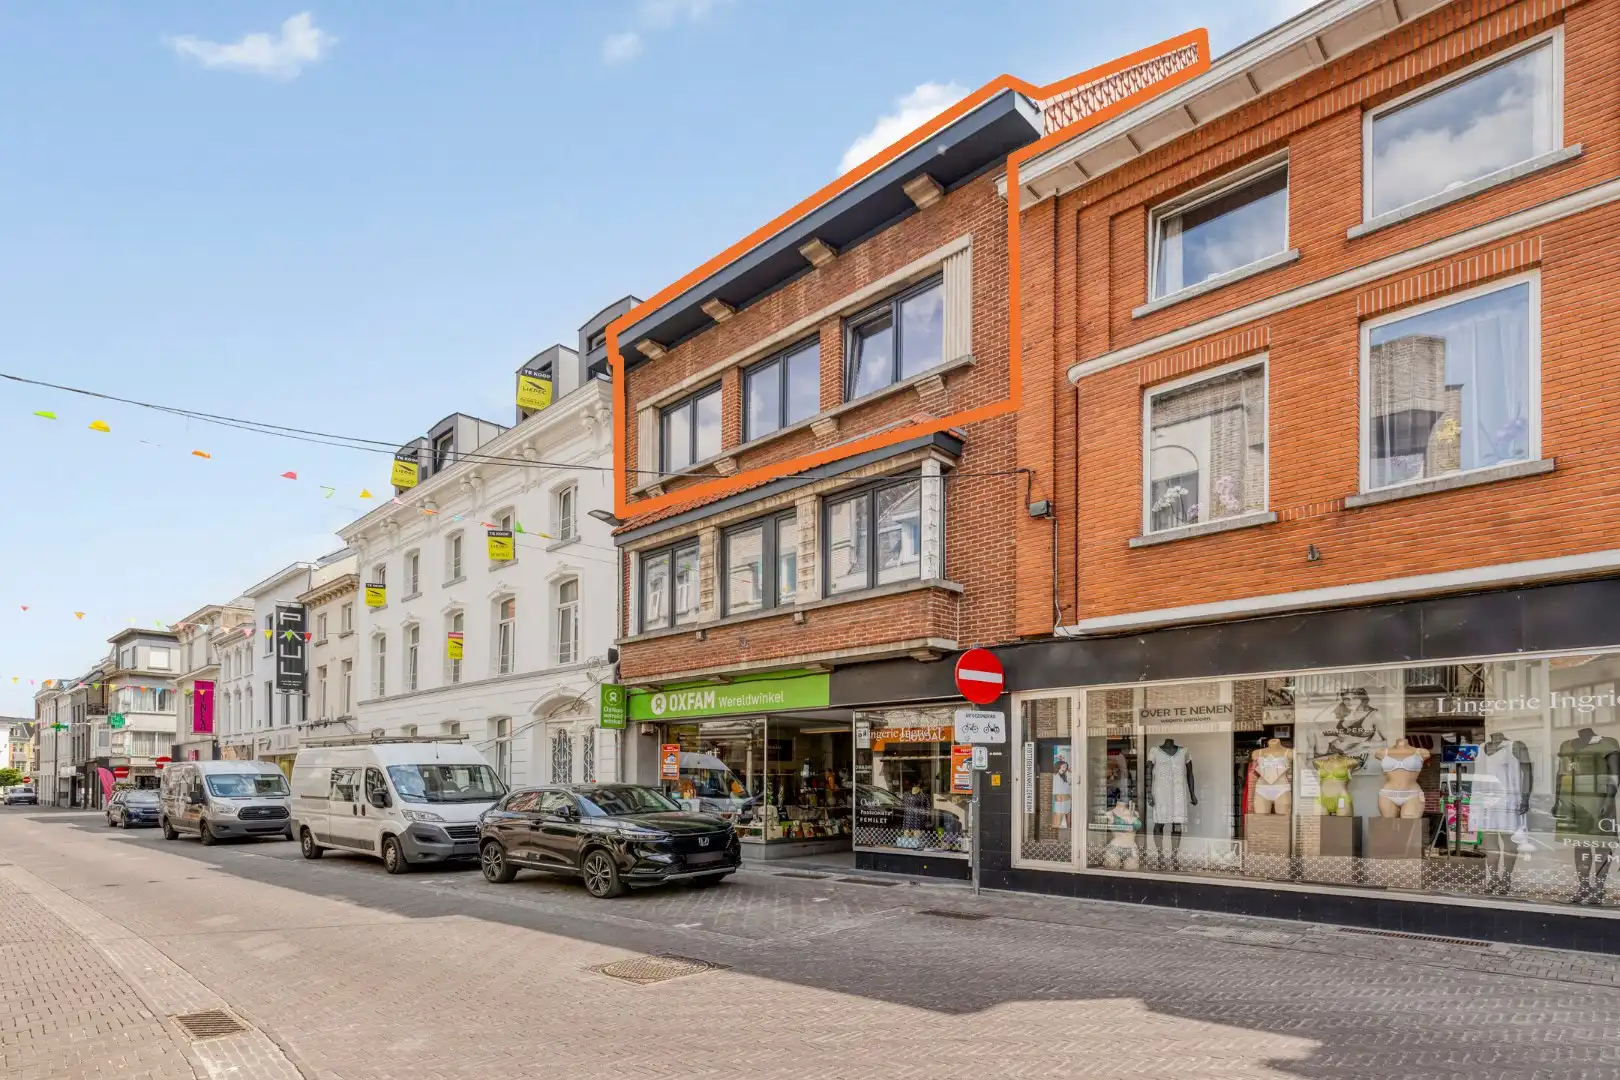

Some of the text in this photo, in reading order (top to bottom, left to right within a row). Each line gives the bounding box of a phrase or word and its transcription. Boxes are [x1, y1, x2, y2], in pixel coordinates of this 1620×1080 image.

[669, 690, 784, 712] OXFAM Wereldwinkel
[1435, 694, 1541, 717] Lingerie
[1140, 704, 1233, 718] OVER TE NEMEN
[1581, 853, 1620, 863] FEM
